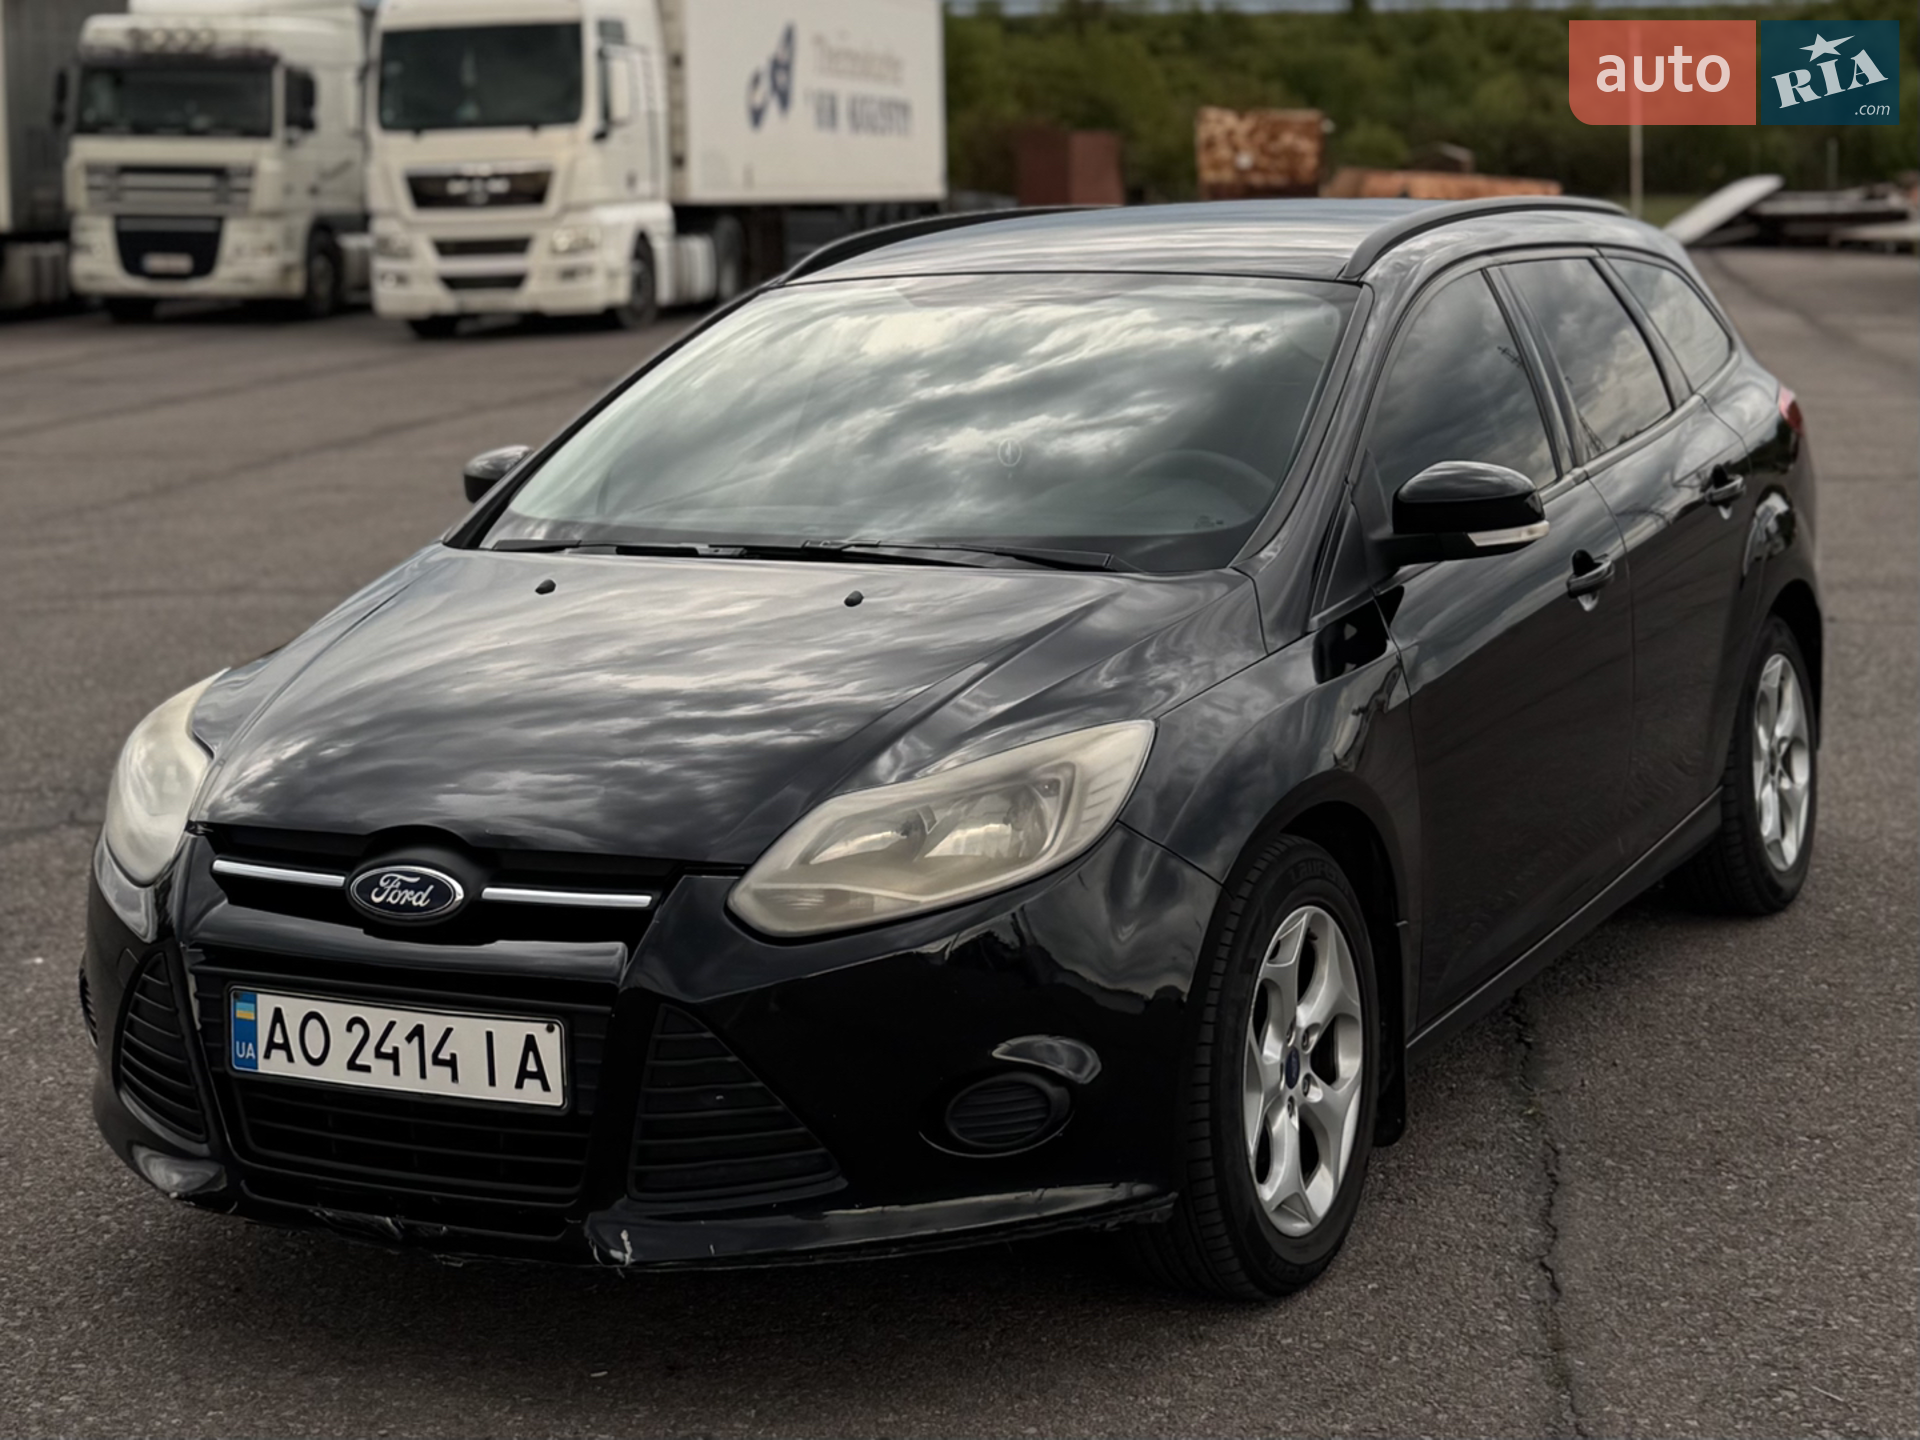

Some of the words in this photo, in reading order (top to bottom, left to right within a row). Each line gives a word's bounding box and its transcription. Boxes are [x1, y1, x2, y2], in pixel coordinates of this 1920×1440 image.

[370, 872, 434, 907] Ford
[236, 1041, 256, 1060] UA
[263, 1006, 331, 1067] AO
[346, 1016, 459, 1084] 2414
[485, 1030, 552, 1093] IA
